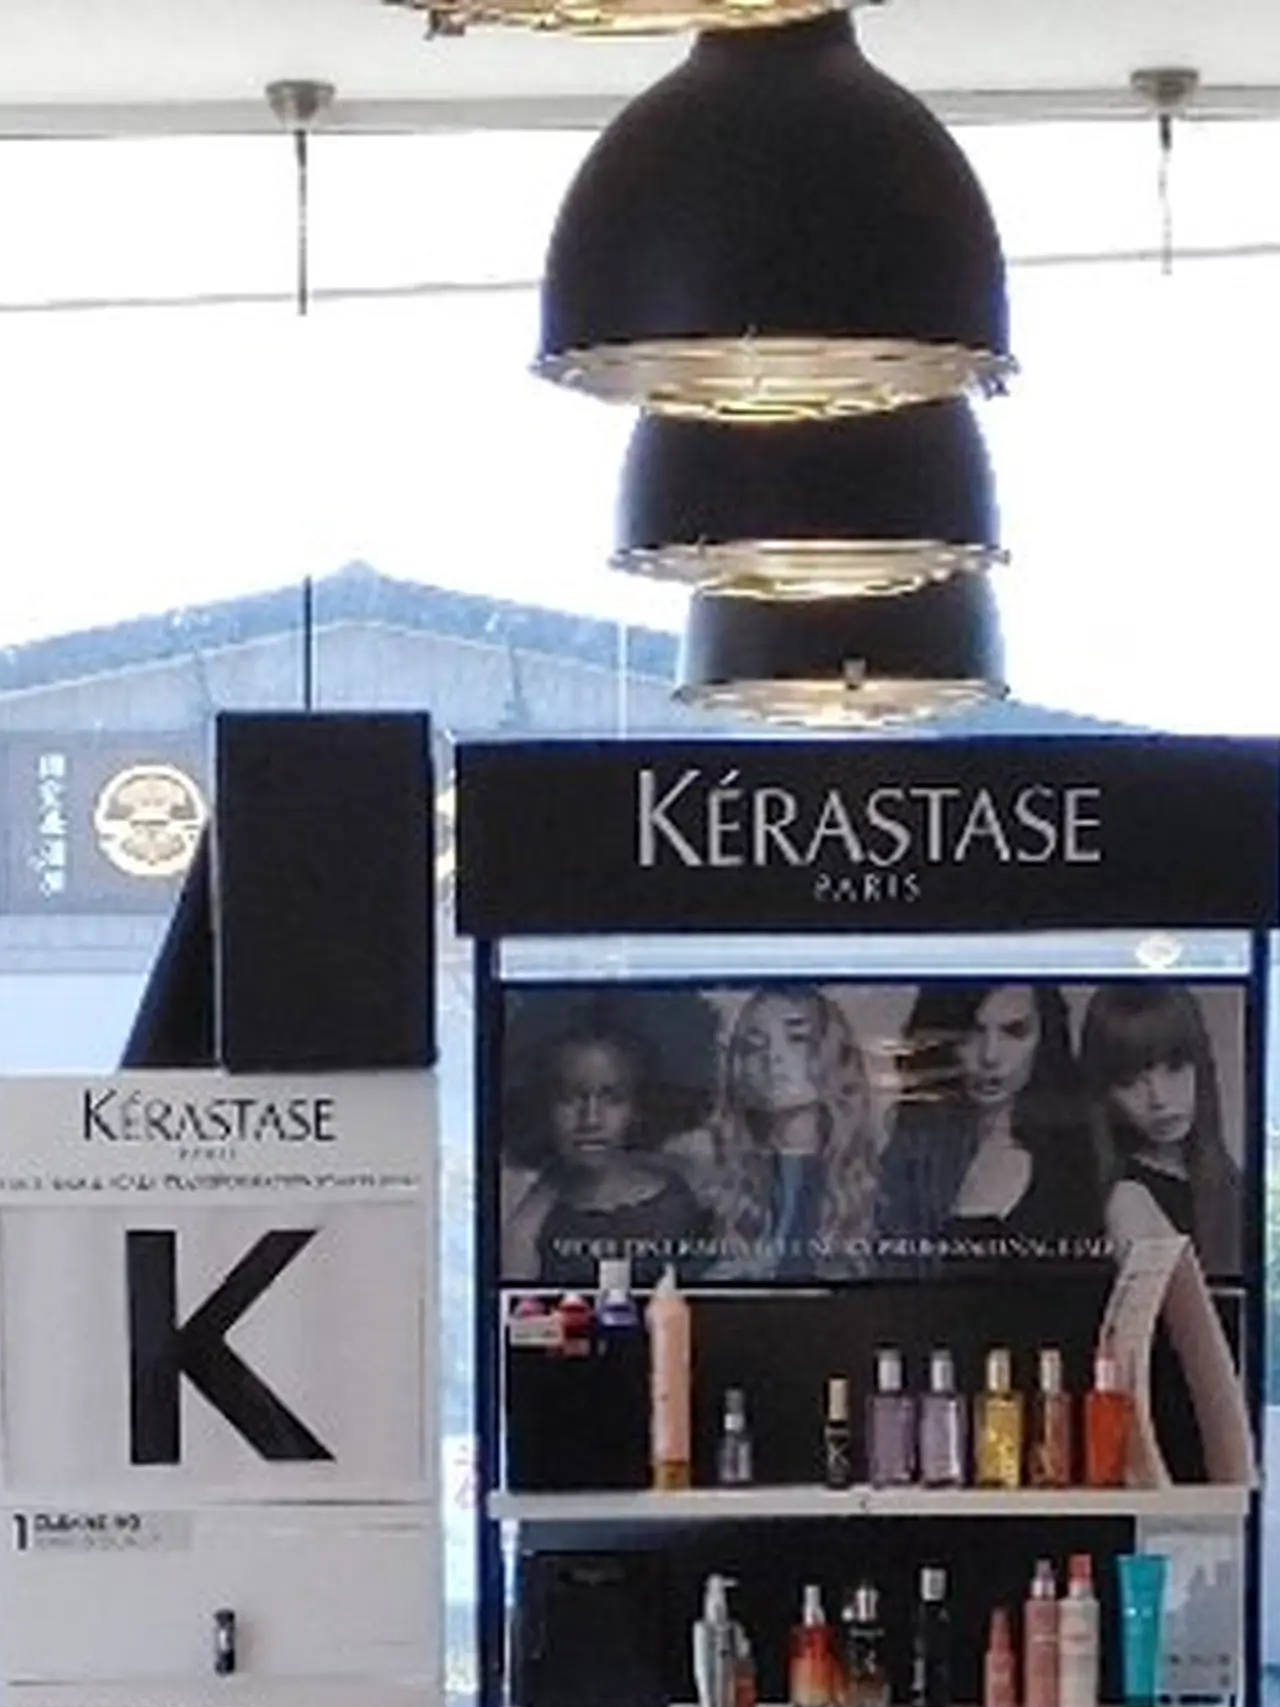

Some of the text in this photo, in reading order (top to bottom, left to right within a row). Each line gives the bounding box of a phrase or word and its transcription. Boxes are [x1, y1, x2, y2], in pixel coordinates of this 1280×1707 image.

[639, 769, 1101, 867] KÉRASTASE
[815, 873, 921, 901] PARIS
[82, 1088, 338, 1142] KÉRASTASE
[125, 1227, 338, 1466] K
[13, 1513, 27, 1551] 1
